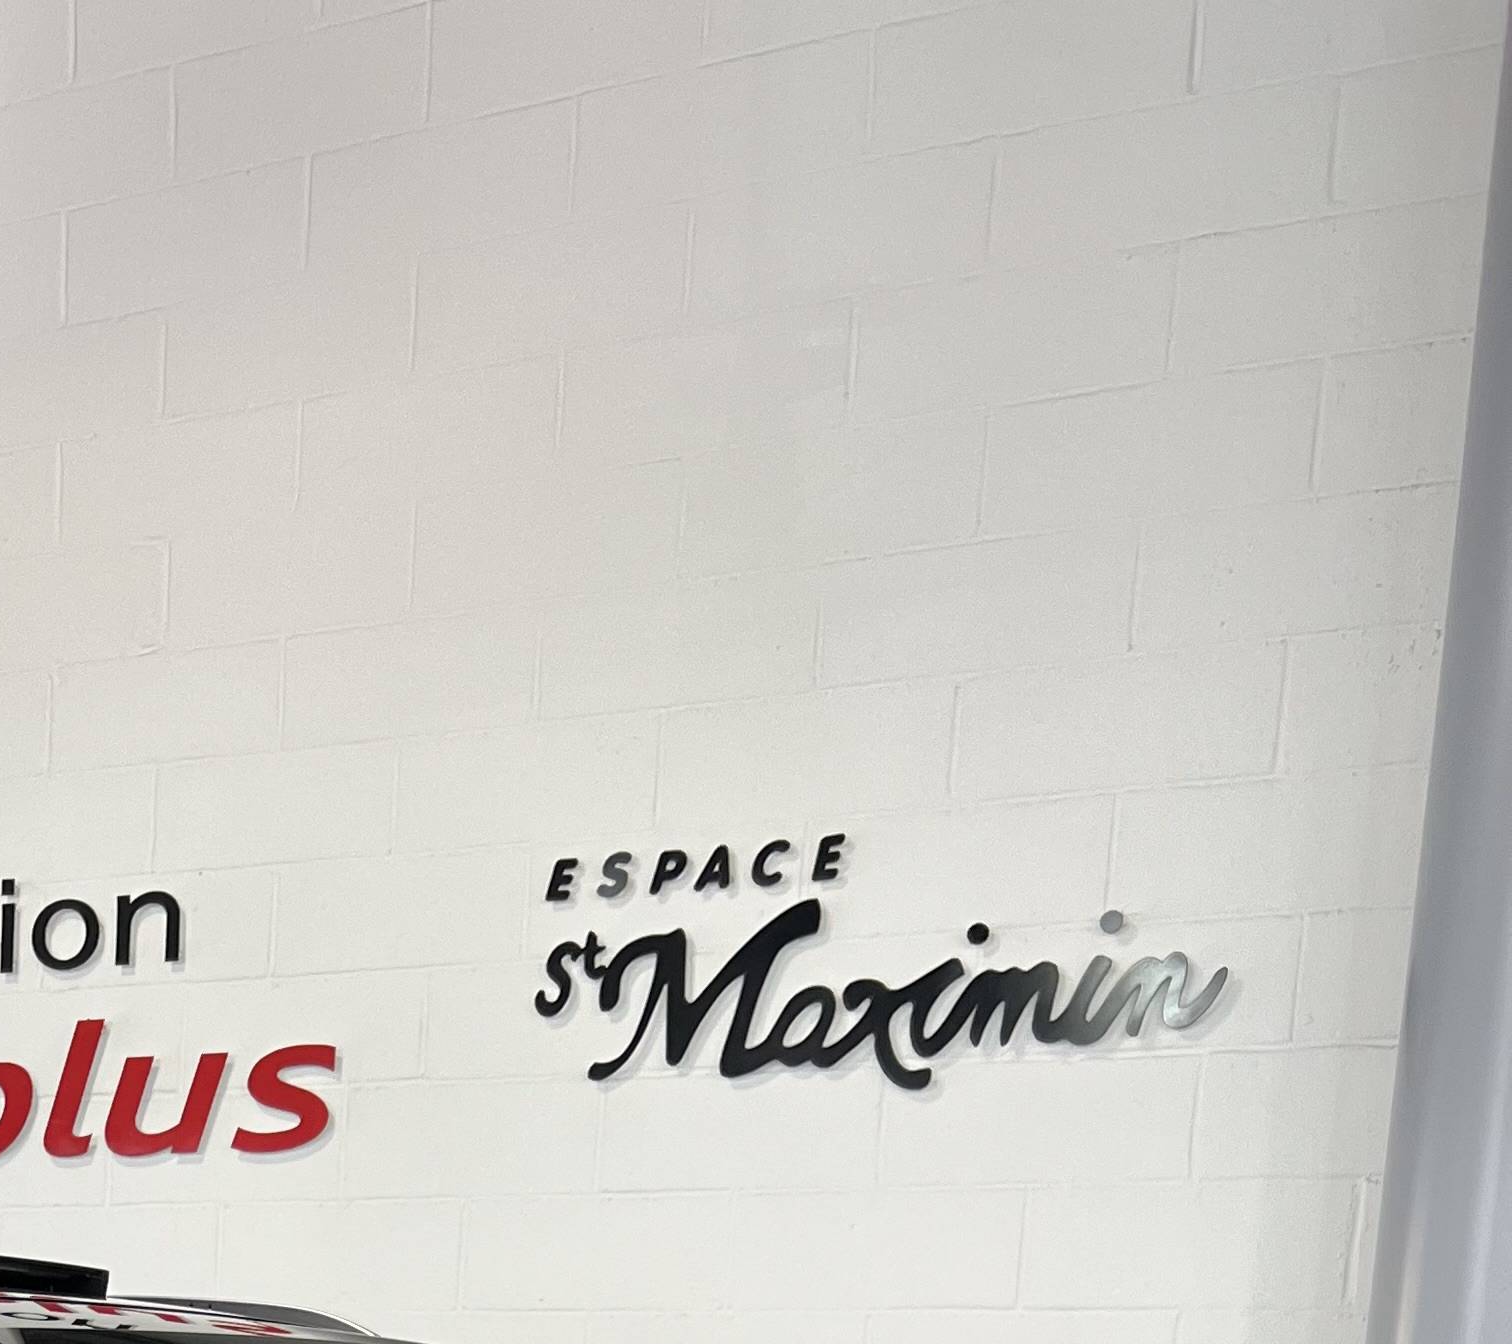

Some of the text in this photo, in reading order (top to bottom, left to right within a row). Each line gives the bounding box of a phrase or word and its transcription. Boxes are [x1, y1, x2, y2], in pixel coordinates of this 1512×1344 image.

[545, 832, 846, 902] ESPACE
[534, 896, 1229, 1090] St Maximin
